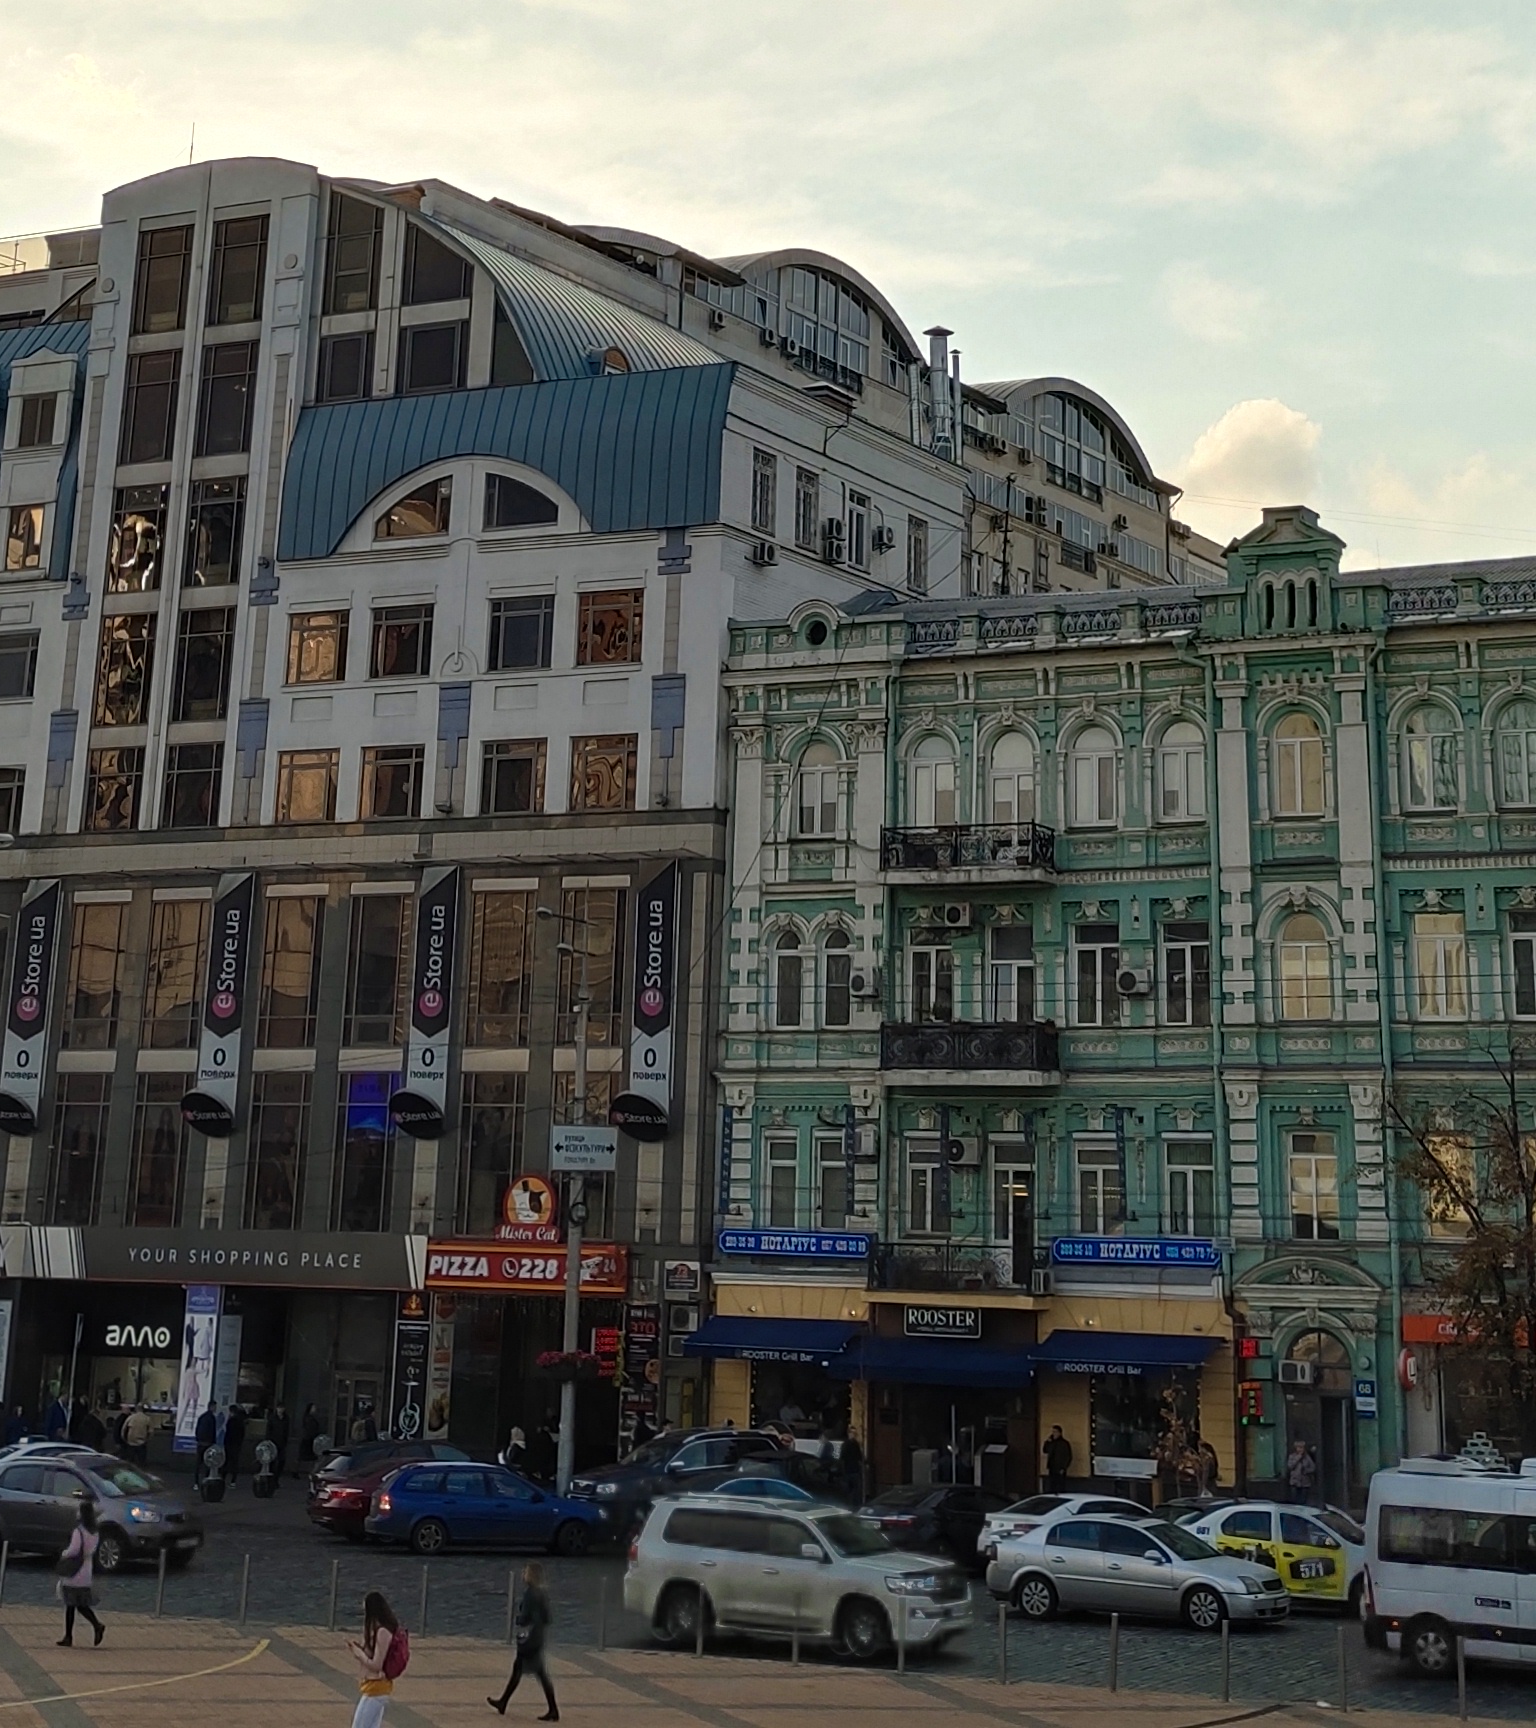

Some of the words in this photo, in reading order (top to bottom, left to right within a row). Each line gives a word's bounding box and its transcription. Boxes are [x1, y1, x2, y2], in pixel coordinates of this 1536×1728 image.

[17, 1050, 30, 1067] 0
[213, 1048, 226, 1066] 0
[421, 1048, 435, 1067] 0
[644, 1048, 657, 1067] 0
[495, 1225, 533, 1240] Mister
[760, 1236, 817, 1252] НОТАРІУС
[1100, 1243, 1161, 1259] НОТАРІУС
[128, 1247, 177, 1264] YOUR
[188, 1248, 289, 1267] SHOPPING
[301, 1252, 362, 1269] PLACE
[429, 1255, 490, 1278] PIZZA
[518, 1258, 559, 1280] 228
[908, 1309, 976, 1327] ROOSTER
[742, 1349, 780, 1361] ROOSTER
[781, 1351, 798, 1362] Grill
[799, 1352, 815, 1363] Bar
[1064, 1362, 1106, 1374] ROOSTER
[1107, 1364, 1125, 1375] Grill
[1126, 1365, 1143, 1376] Bar
